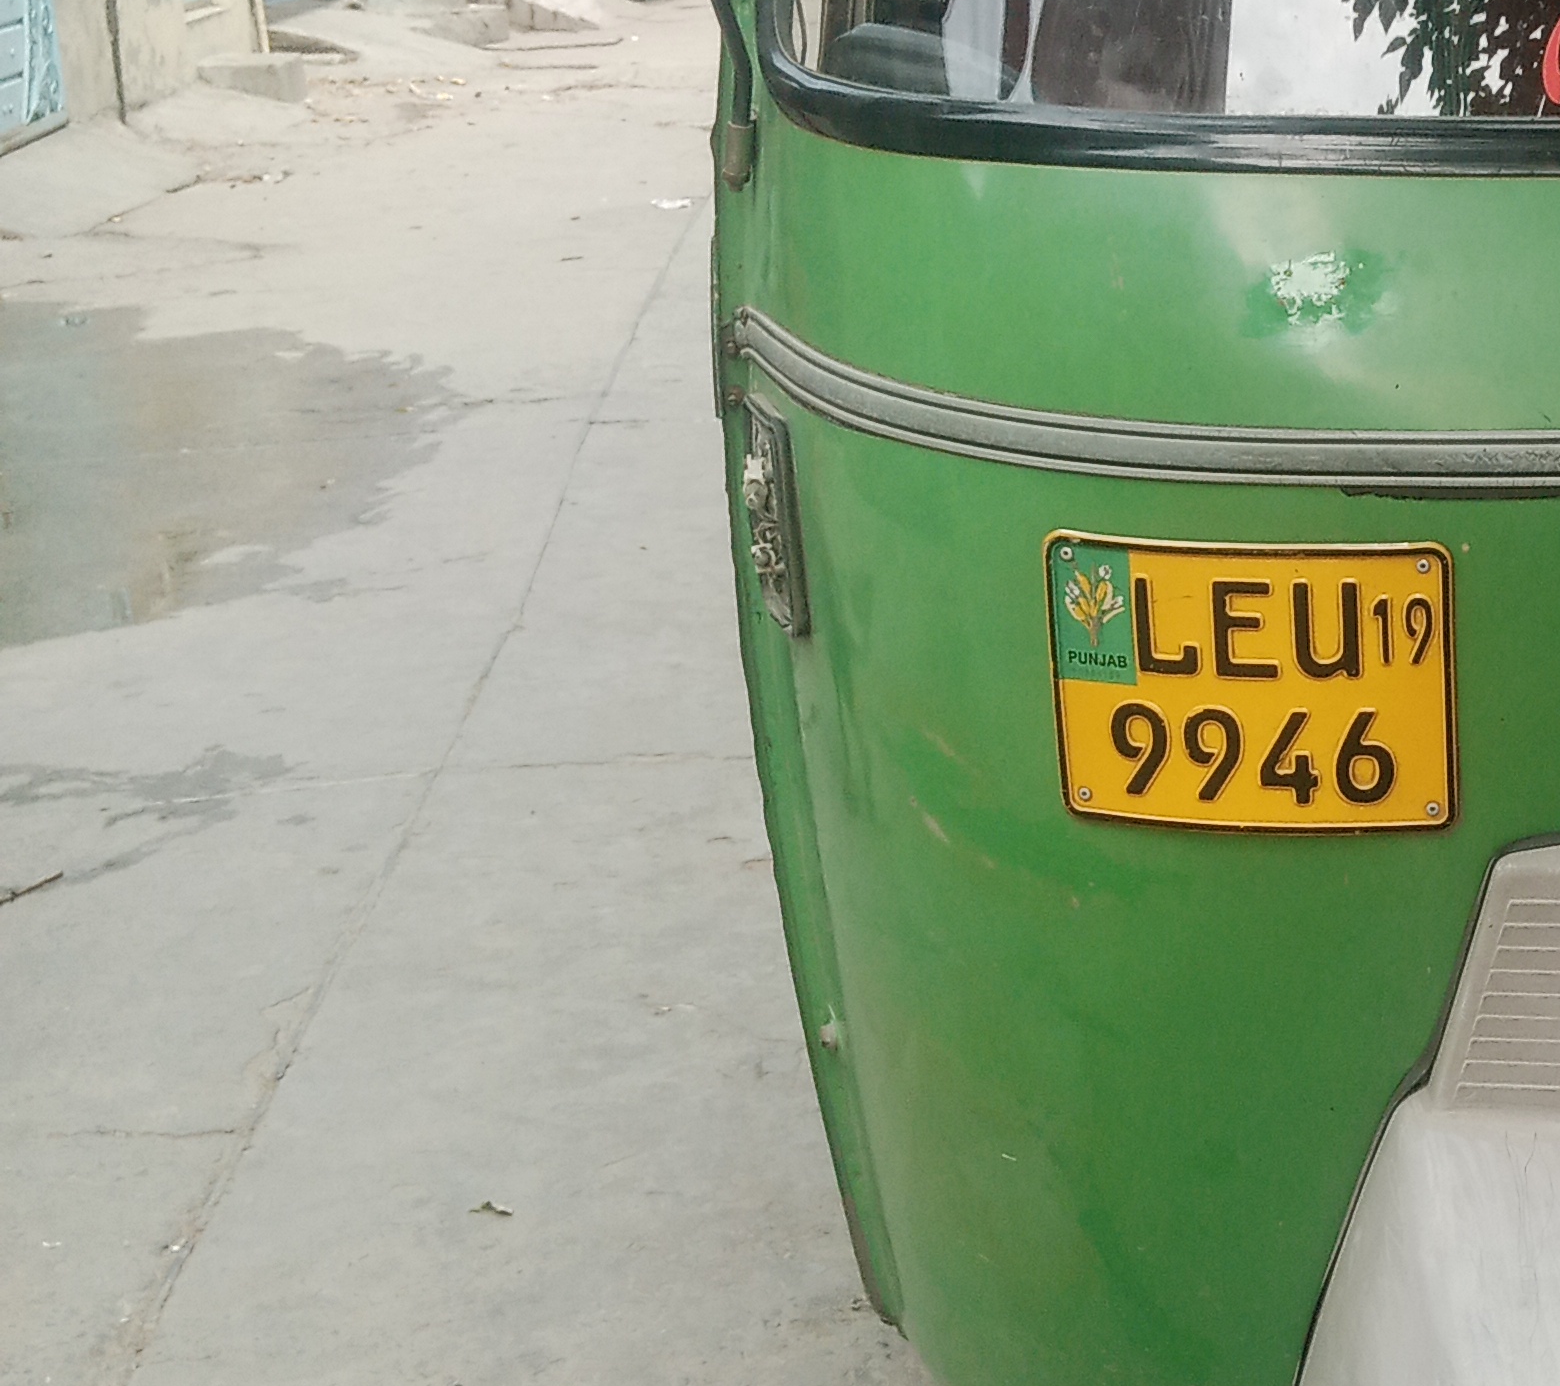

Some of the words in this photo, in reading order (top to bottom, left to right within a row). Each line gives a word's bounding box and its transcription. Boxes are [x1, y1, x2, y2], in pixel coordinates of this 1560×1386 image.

[1068, 650, 1128, 668] PUNJAB
[1133, 574, 1363, 681] LEU
[1370, 593, 1436, 665] 19
[1108, 700, 1399, 806] 9946
